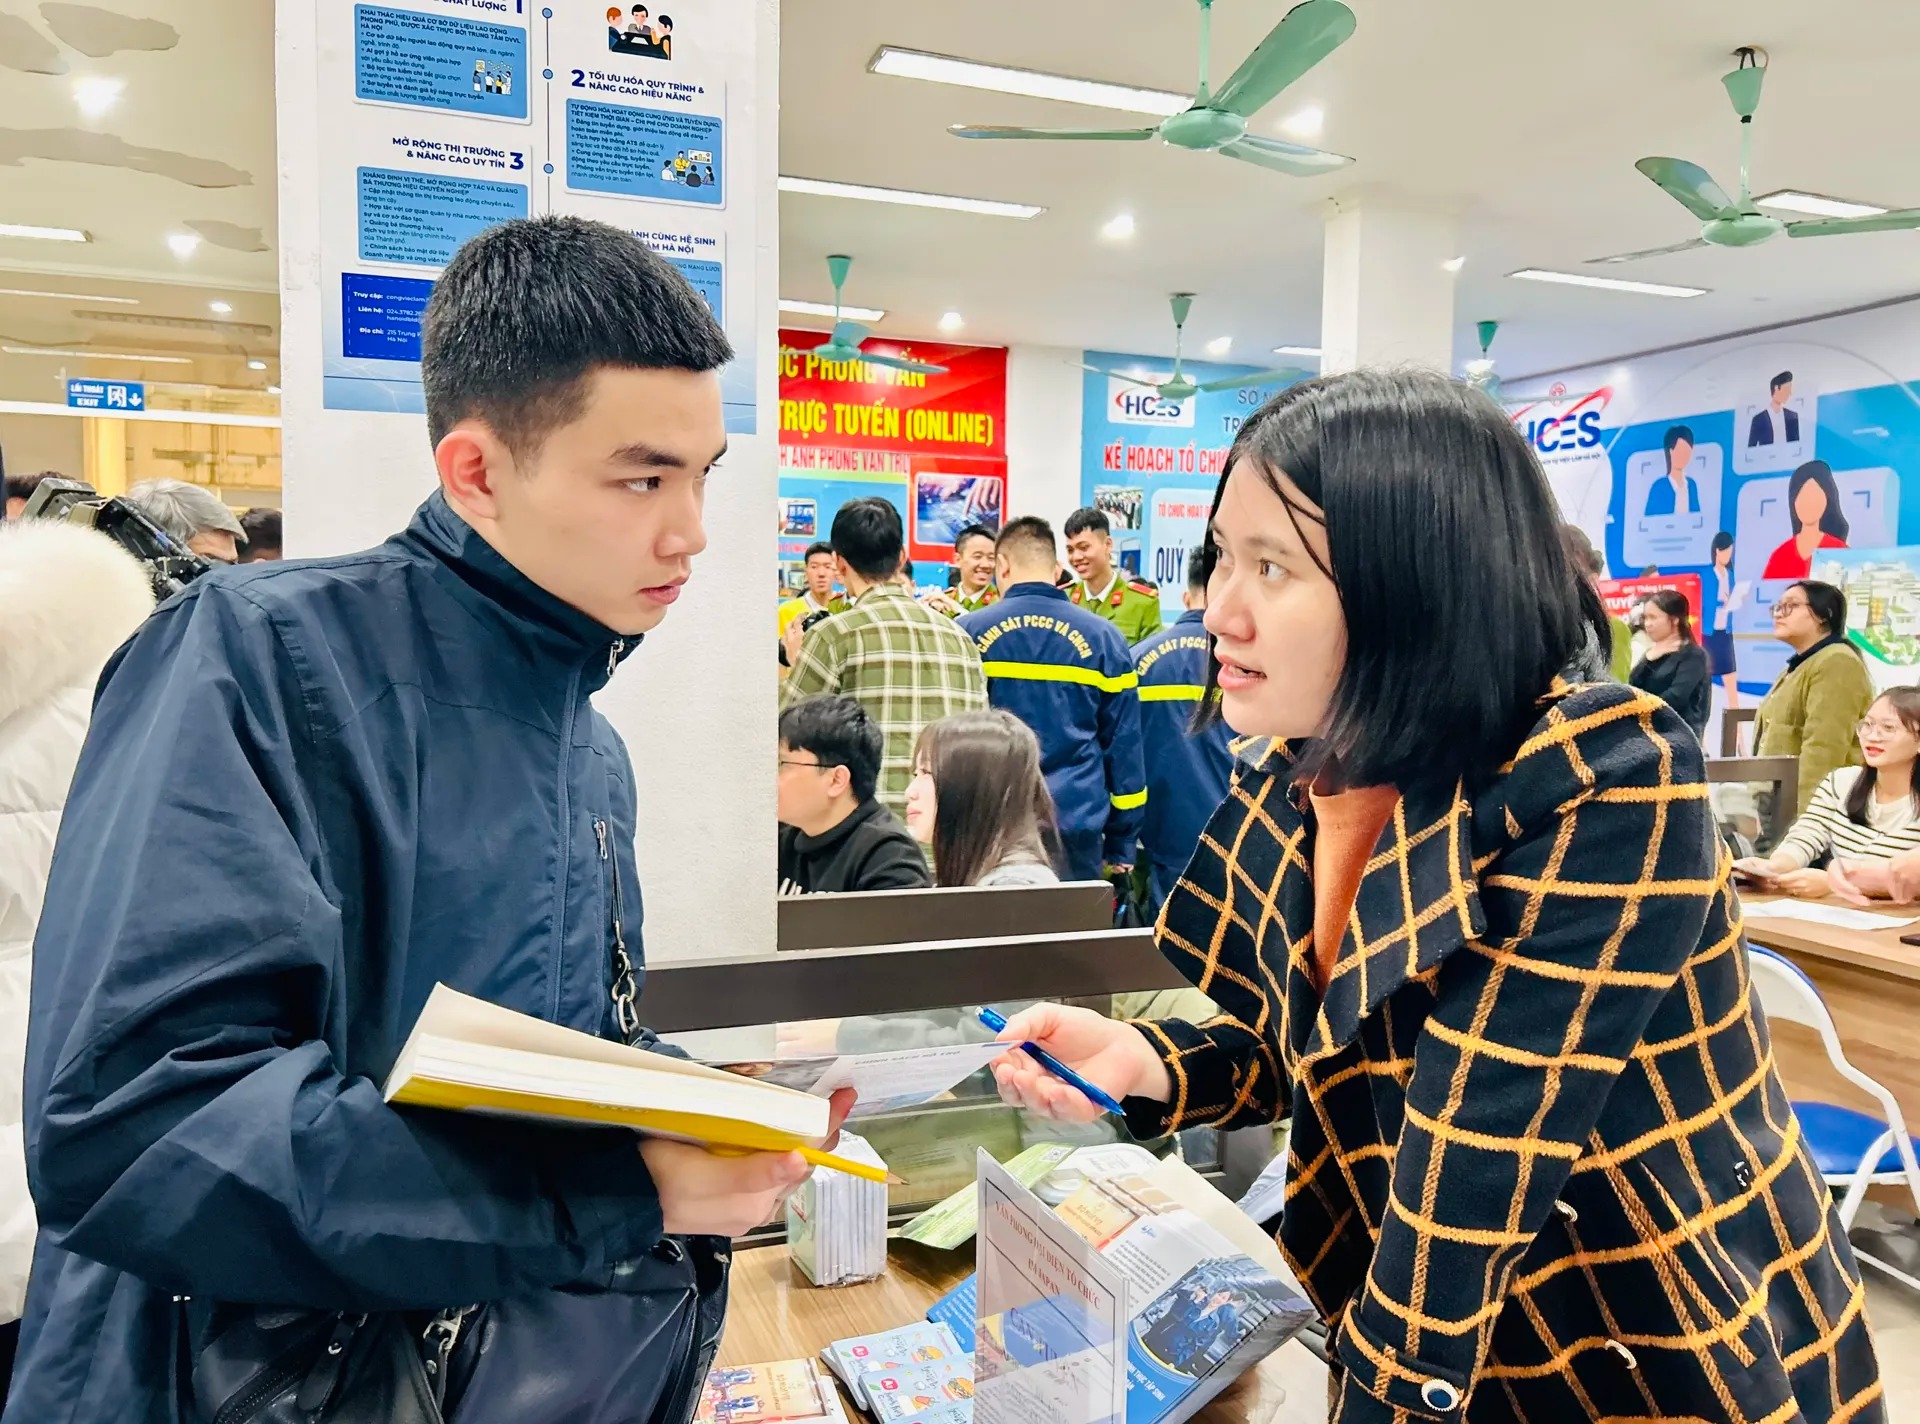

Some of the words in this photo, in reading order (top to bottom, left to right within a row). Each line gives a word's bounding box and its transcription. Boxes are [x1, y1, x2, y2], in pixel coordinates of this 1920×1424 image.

[472, 0, 507, 11] LƯỢNG
[571, 69, 585, 88] 2
[589, 70, 604, 80] TỐI
[607, 74, 620, 82] ƯU
[623, 75, 644, 86] HÓA
[646, 80, 666, 89] QUY
[668, 82, 696, 93] TRÌNH
[589, 82, 616, 92] NÂNG
[619, 86, 638, 95] CAO
[642, 89, 663, 99] HIỆU
[666, 92, 692, 102] NĂNG
[393, 136, 409, 146] MỞ
[412, 139, 442, 151] RỘNG
[444, 144, 460, 154] THỊ
[463, 146, 505, 158] TRƯỜNG
[417, 150, 446, 162] NÂNG
[448, 155, 470, 164] CAO
[473, 158, 487, 166] UY
[489, 159, 505, 168] TÍN
[509, 152, 524, 170] 3
[652, 232, 677, 242] CÙNG
[680, 234, 692, 244] HỆ
[694, 237, 716, 246] SINH
[662, 243, 675, 251] HÀ
[678, 245, 694, 254] NỘI
[77, 398, 99, 407] EXIT
[833, 397, 899, 438] TUYẾN
[906, 408, 993, 446] (ONLINE)
[1104, 438, 1123, 470] KẾ
[1127, 446, 1173, 478] HOẠCH
[1178, 440, 1196, 473] TỔ
[1156, 539, 1184, 587] QUÝ
[977, 625, 1003, 653] CẢNH
[1000, 616, 1021, 632] SÁT
[1023, 615, 1054, 630] PCCC
[1054, 620, 1070, 636] VÀ
[1068, 630, 1093, 659] CNCH
[1158, 639, 1177, 655] SÁT
[1180, 636, 1206, 650] PCCC
